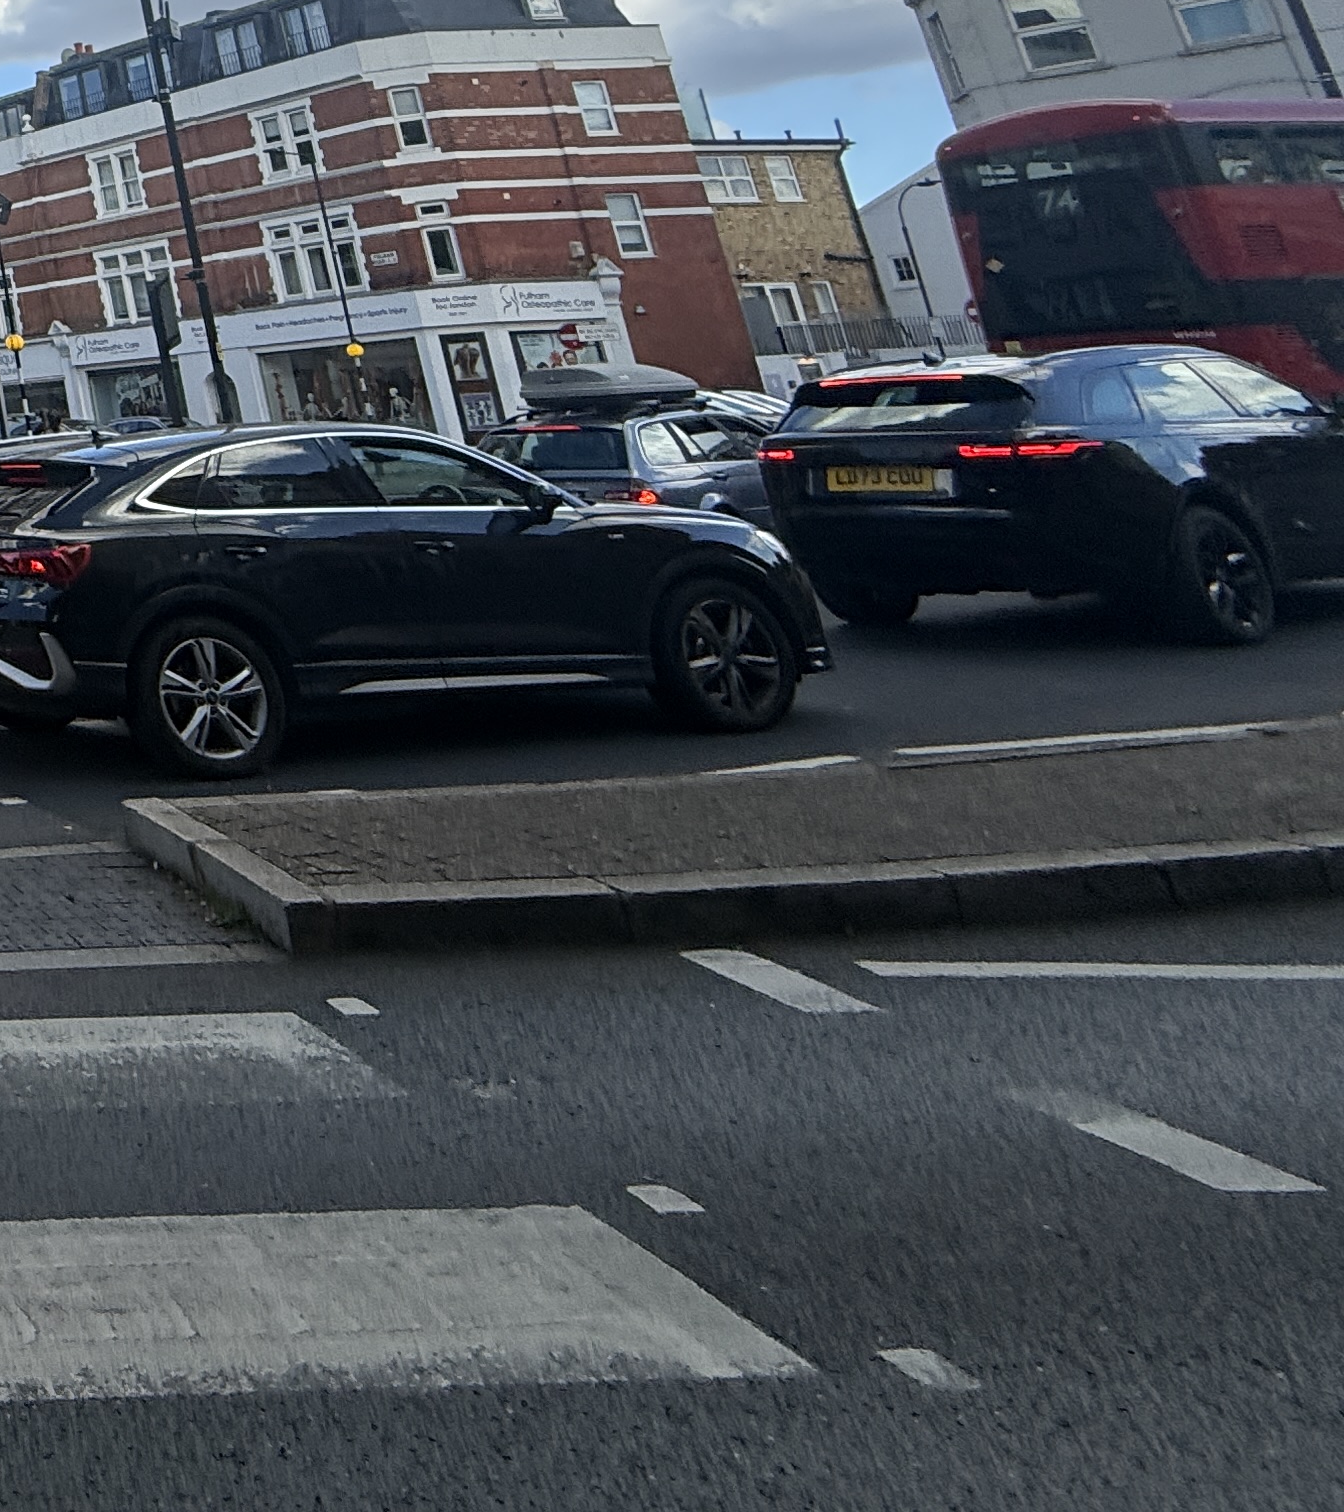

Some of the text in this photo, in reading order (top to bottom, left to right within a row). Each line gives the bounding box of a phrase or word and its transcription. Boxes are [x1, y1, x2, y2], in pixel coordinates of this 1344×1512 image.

[519, 291, 550, 300] Fulham
[521, 298, 596, 309] Osteopathic Care
